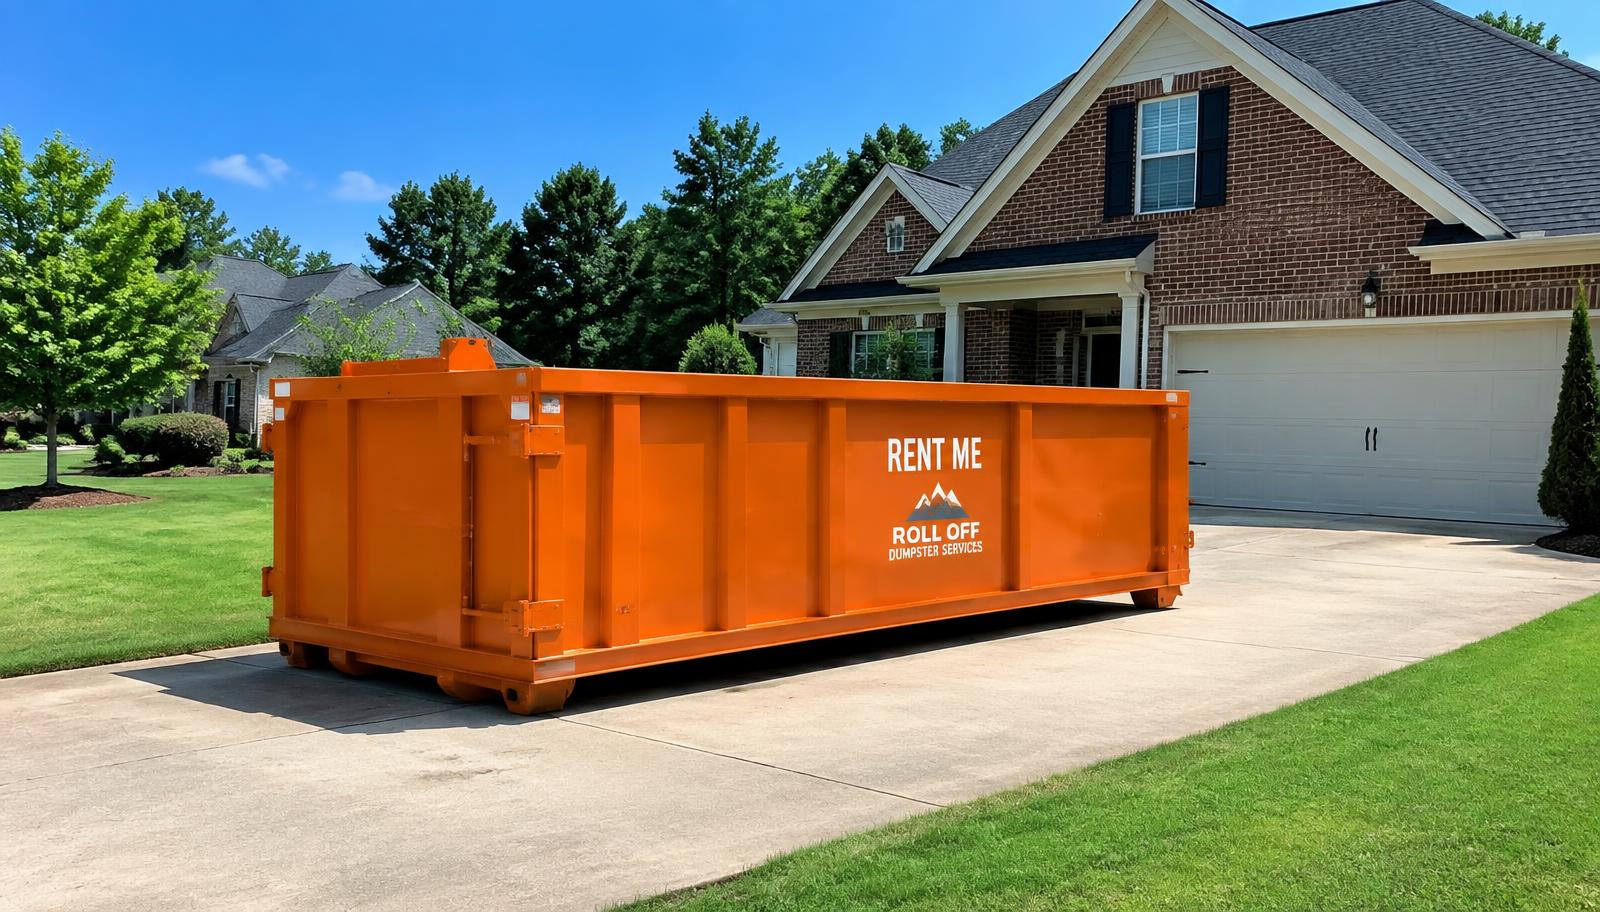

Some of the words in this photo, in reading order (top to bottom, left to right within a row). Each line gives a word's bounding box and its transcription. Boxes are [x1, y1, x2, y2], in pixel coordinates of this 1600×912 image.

[888, 437, 945, 472] RENT
[952, 437, 982, 469] ME
[892, 524, 942, 545] ROLL
[946, 521, 980, 540] OFF
[888, 545, 939, 561] DUMPSTER
[942, 541, 983, 555] SERVICES
